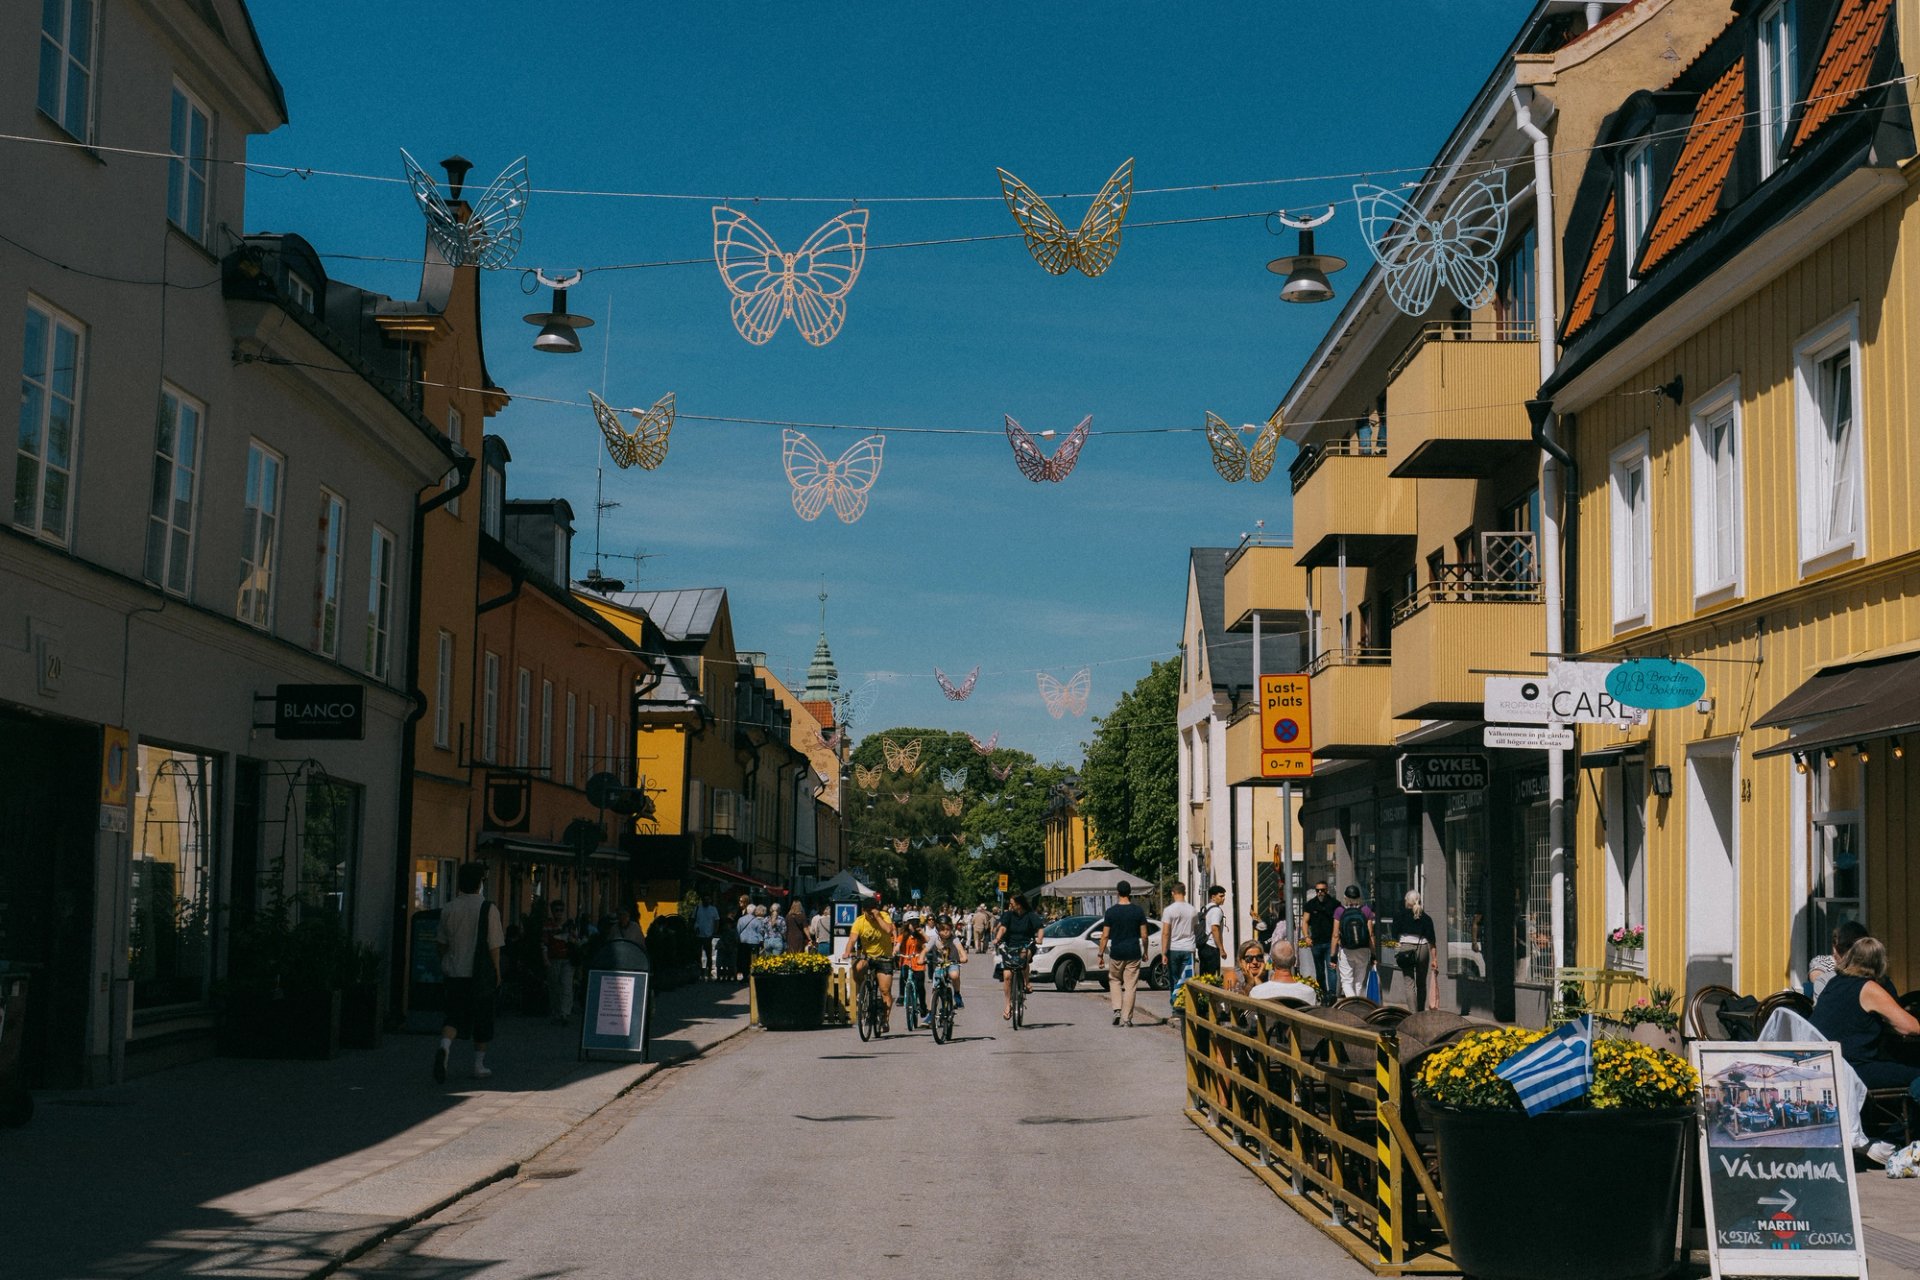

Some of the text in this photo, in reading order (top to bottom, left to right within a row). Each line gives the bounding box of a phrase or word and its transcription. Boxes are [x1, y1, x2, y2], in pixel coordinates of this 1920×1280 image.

[47, 655, 61, 679] 20
[1646, 671, 1689, 683] Brodin
[1267, 682, 1303, 694] Last-
[1268, 696, 1303, 709] plats
[284, 703, 355, 718] BLANCO
[1537, 731, 1546, 739] på
[1547, 731, 1570, 739] gården
[1507, 738, 1526, 746] höger
[1428, 758, 1481, 771] CYKEL
[1426, 774, 1484, 787] VIKTOR
[1741, 778, 1751, 803] 23
[1757, 1220, 1810, 1231] MARTINI
[1808, 1232, 1854, 1245] COSTAS
